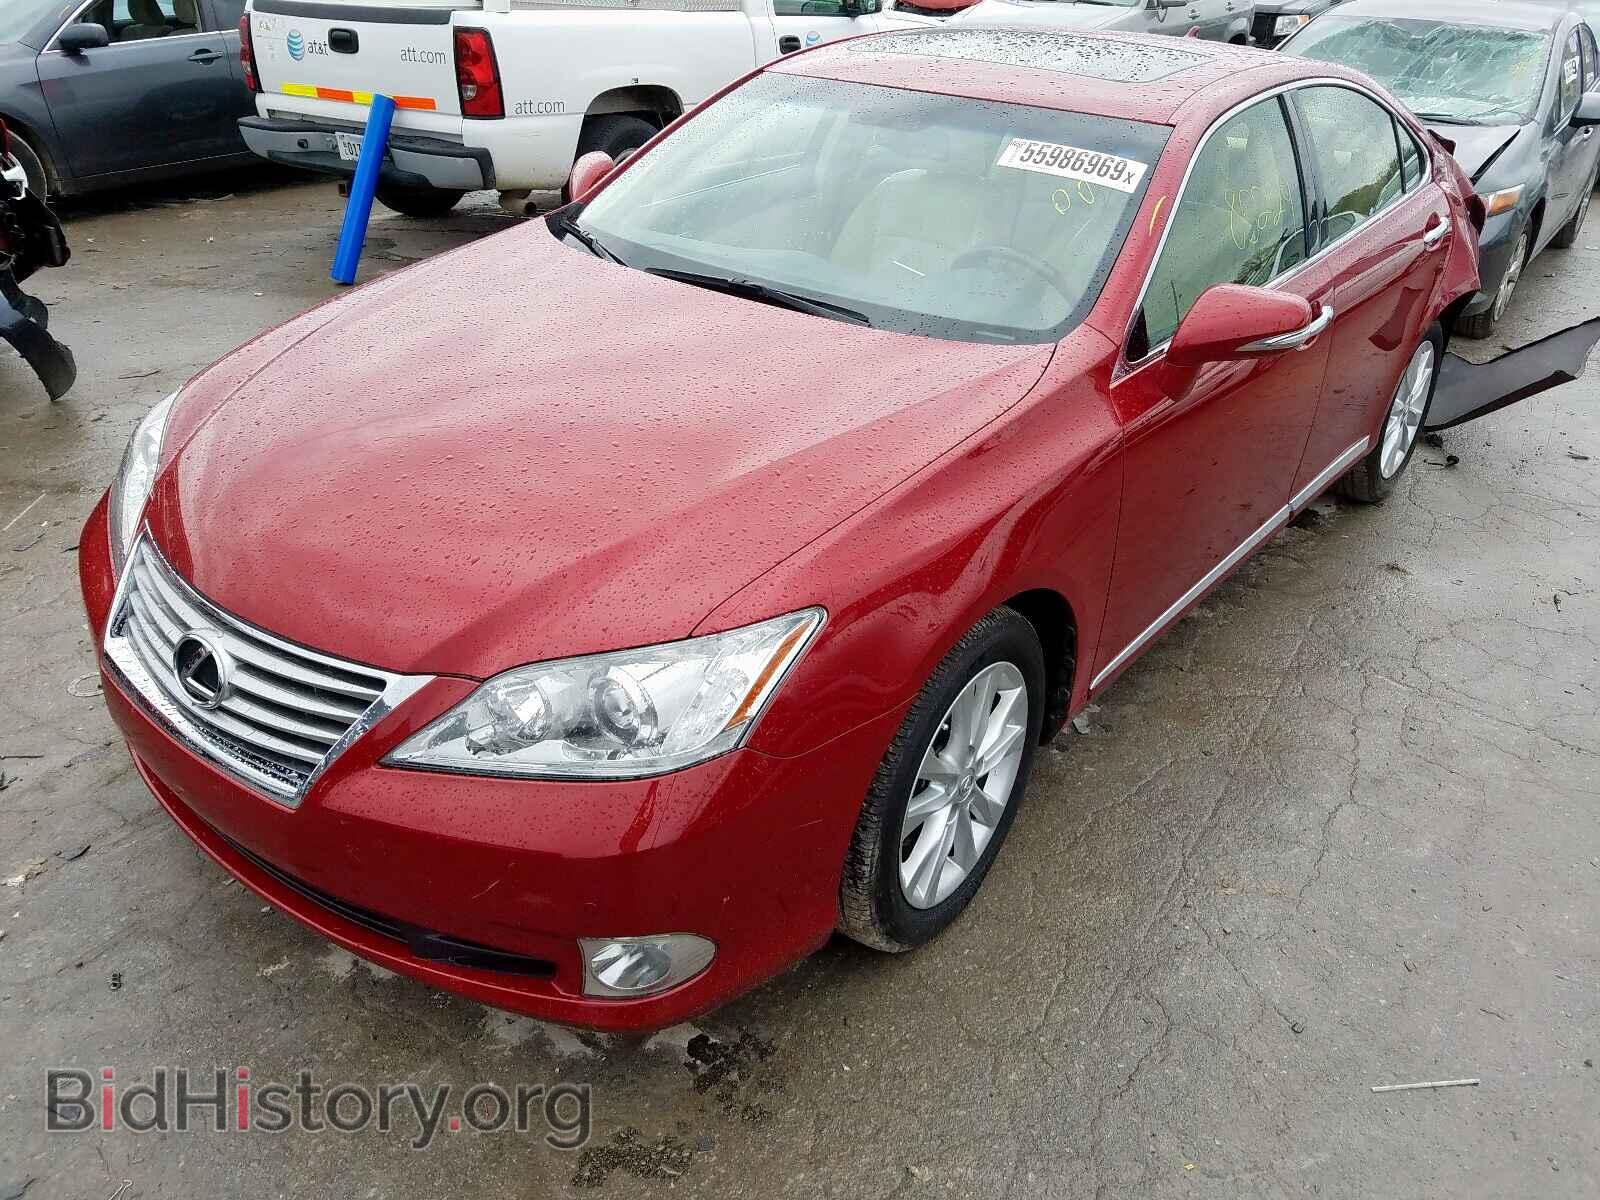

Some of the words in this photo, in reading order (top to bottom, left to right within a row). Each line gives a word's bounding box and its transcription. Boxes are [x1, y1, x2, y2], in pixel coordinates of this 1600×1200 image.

[306, 39, 329, 56] at&t
[400, 47, 447, 65] att.com
[514, 99, 566, 116] att.com
